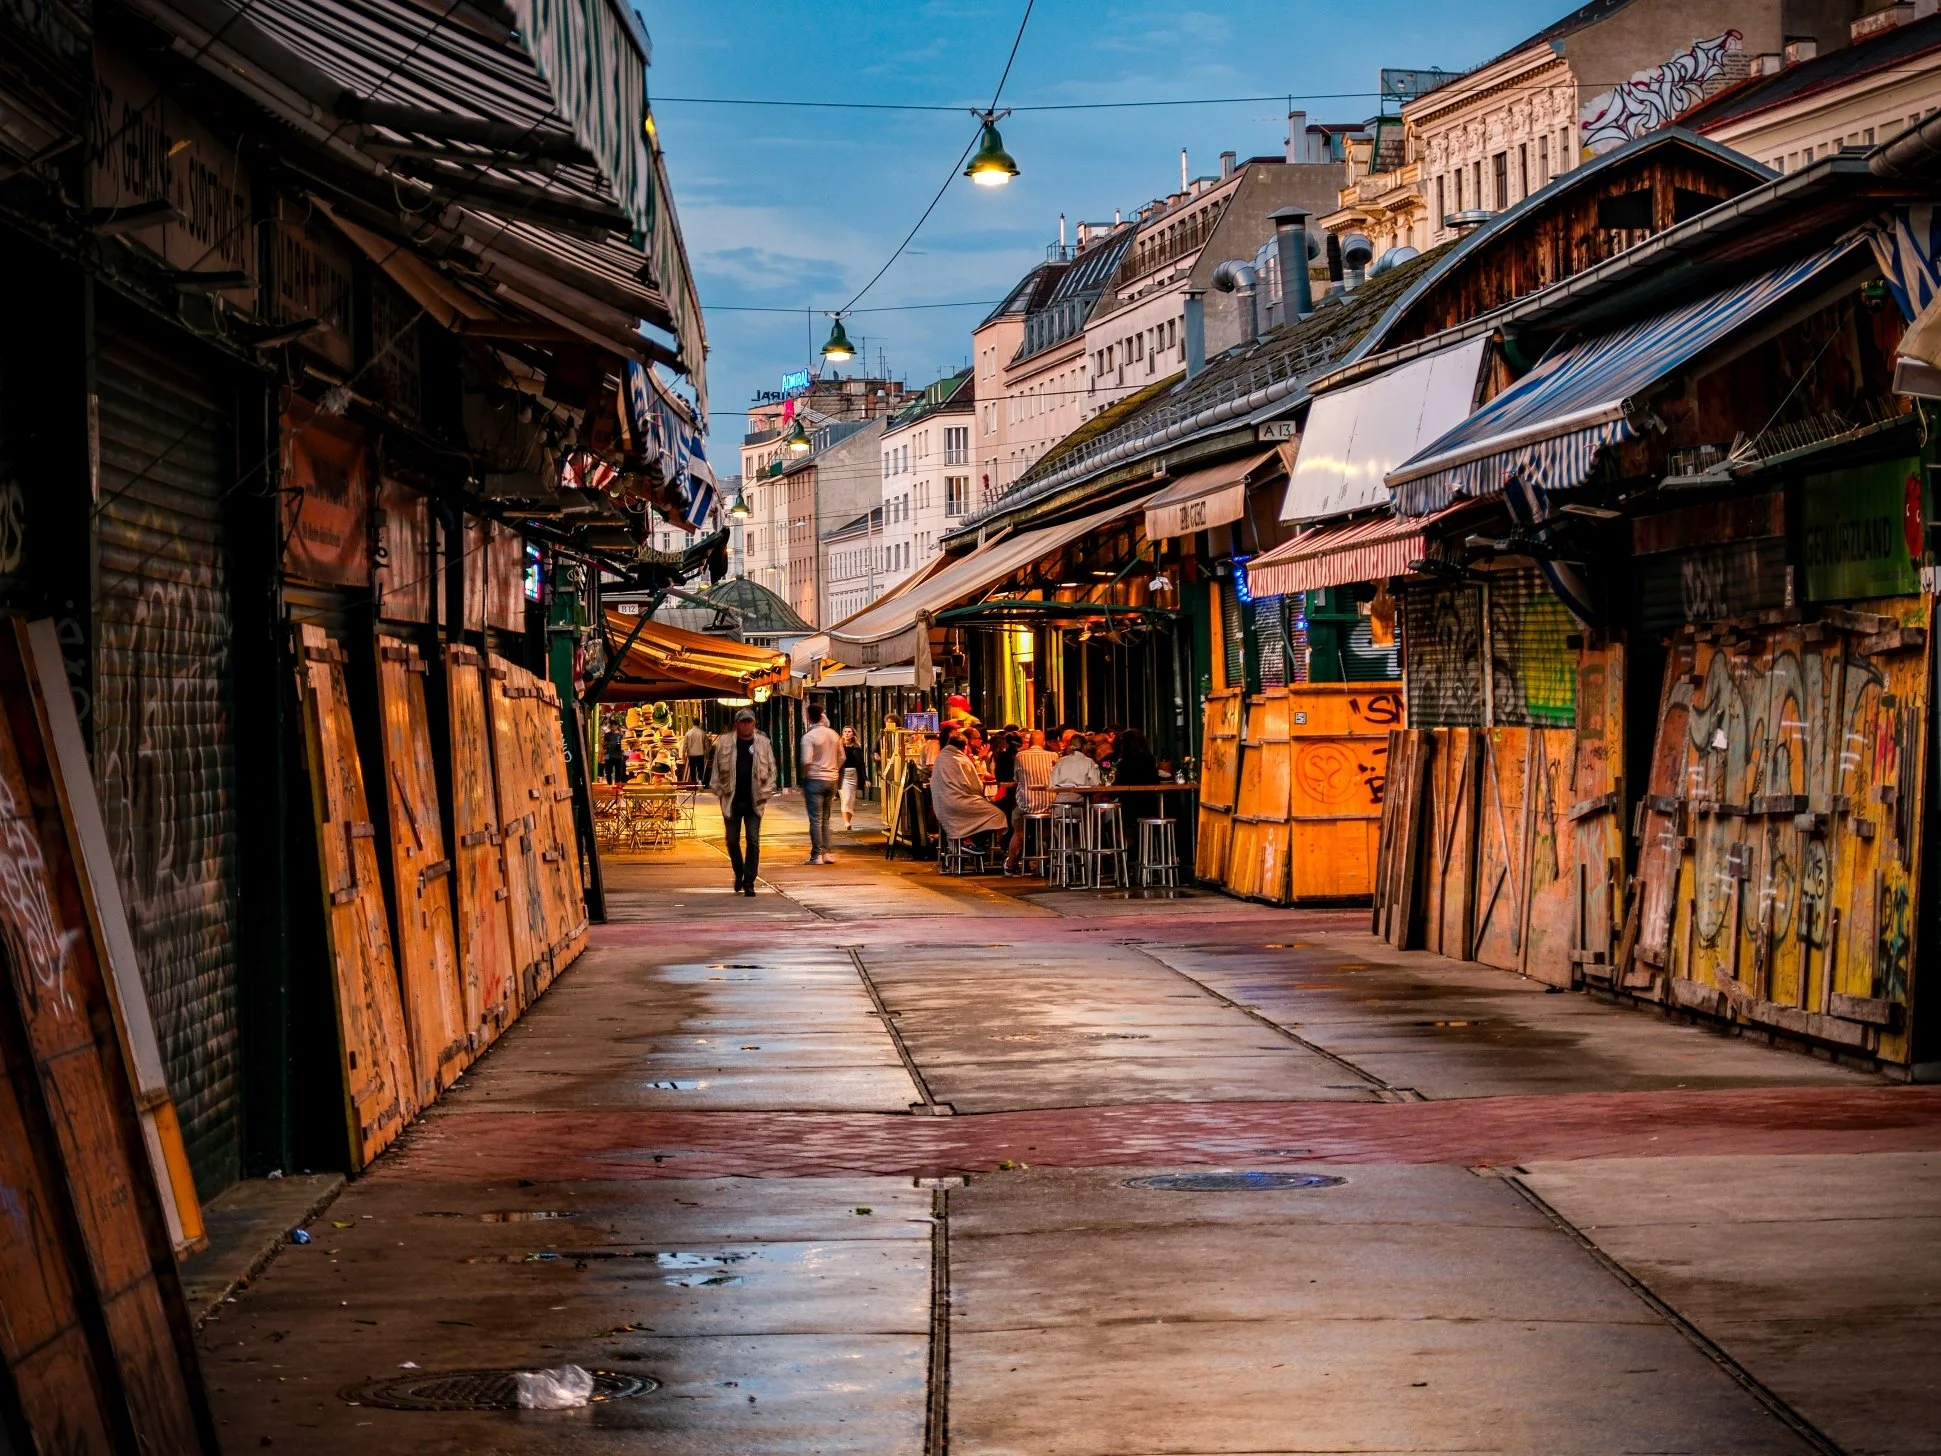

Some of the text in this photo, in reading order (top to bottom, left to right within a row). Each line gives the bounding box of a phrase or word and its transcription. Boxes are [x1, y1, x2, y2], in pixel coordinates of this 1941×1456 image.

[781, 368, 811, 394] ADMIRAL
[1263, 424, 1292, 437] A 13
[1804, 512, 1893, 567] GEWÜRZLAND
[628, 605, 636, 613] 12
